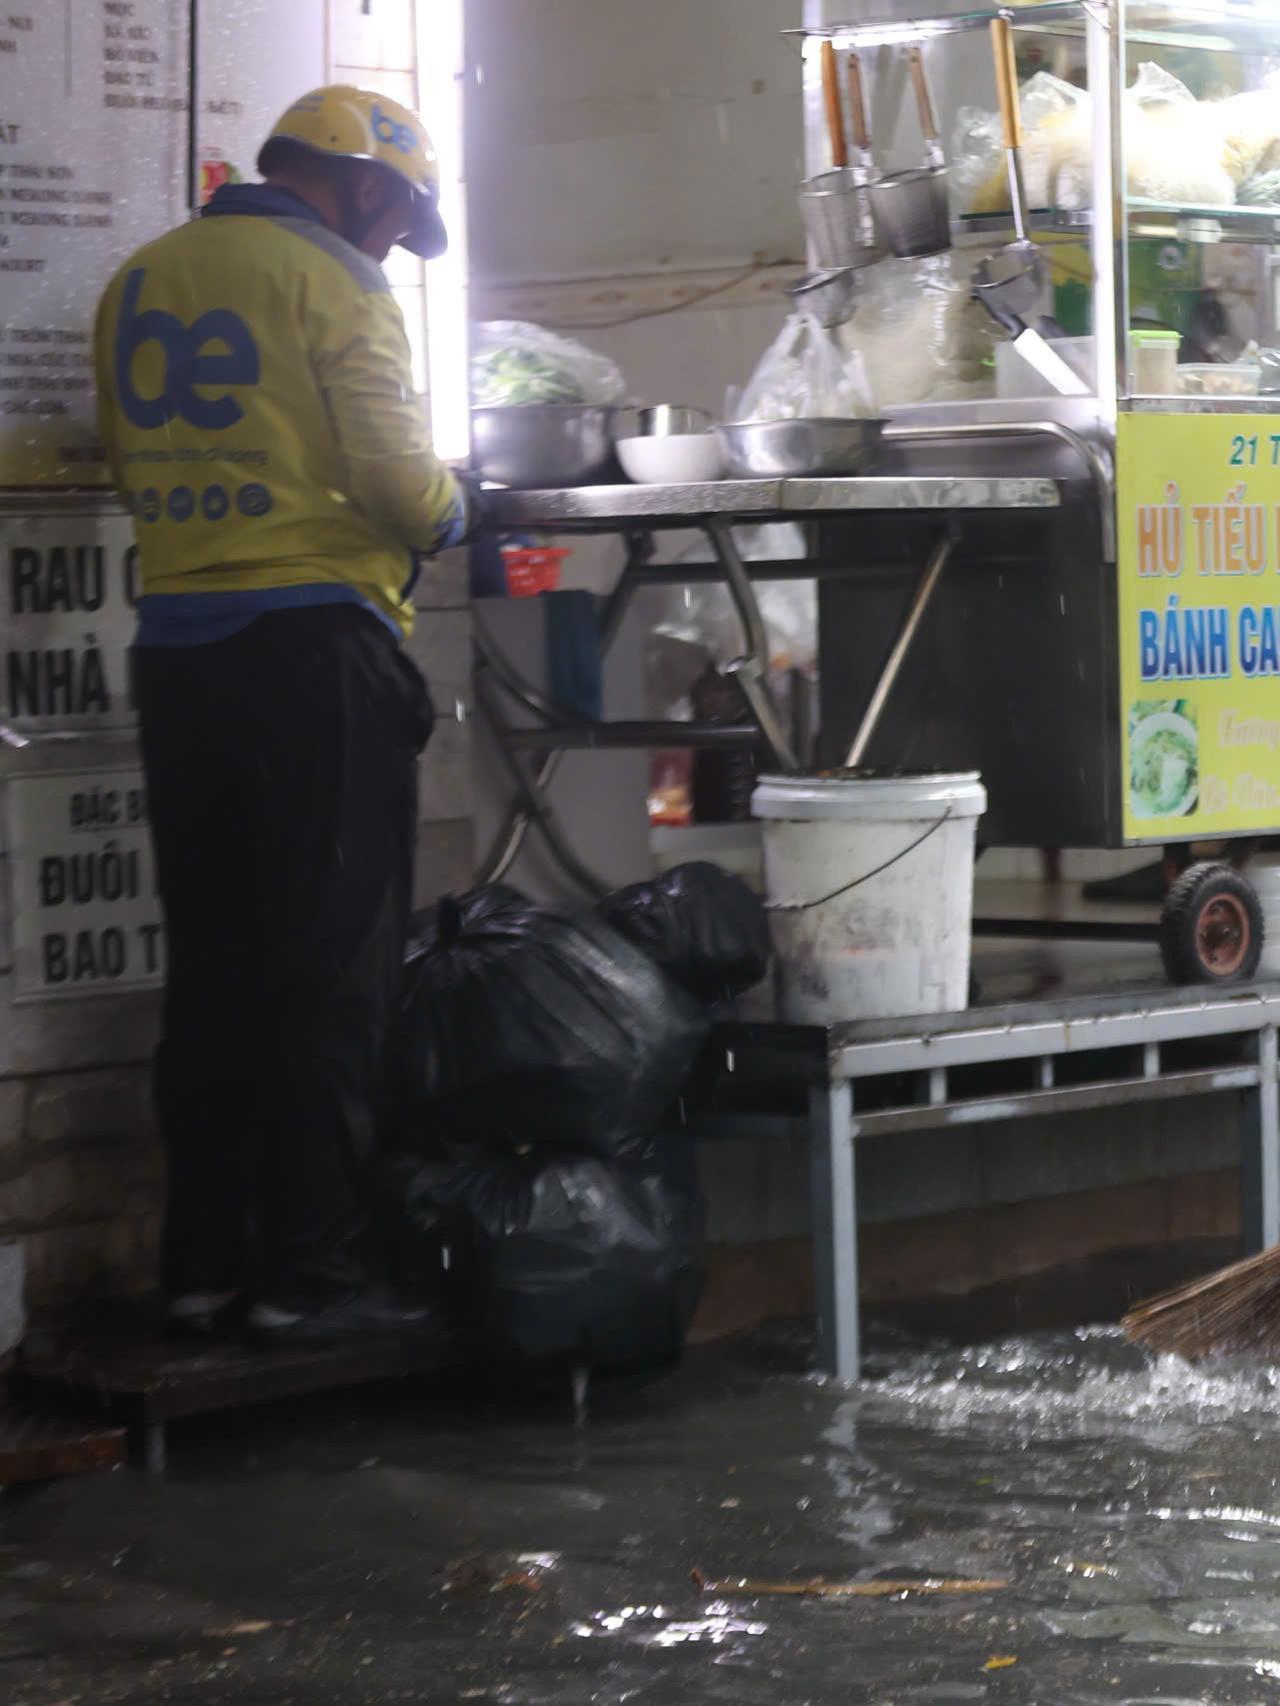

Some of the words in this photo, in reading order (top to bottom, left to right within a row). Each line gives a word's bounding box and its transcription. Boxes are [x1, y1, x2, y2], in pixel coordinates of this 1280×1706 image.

[113, 267, 260, 431] be
[1229, 434, 1258, 466] 21
[1136, 481, 1184, 577] HỦ
[1192, 482, 1267, 576] TIẾU
[12, 545, 104, 614] RAU
[1139, 593, 1231, 682] BÁNH
[44, 926, 125, 984] BAO
